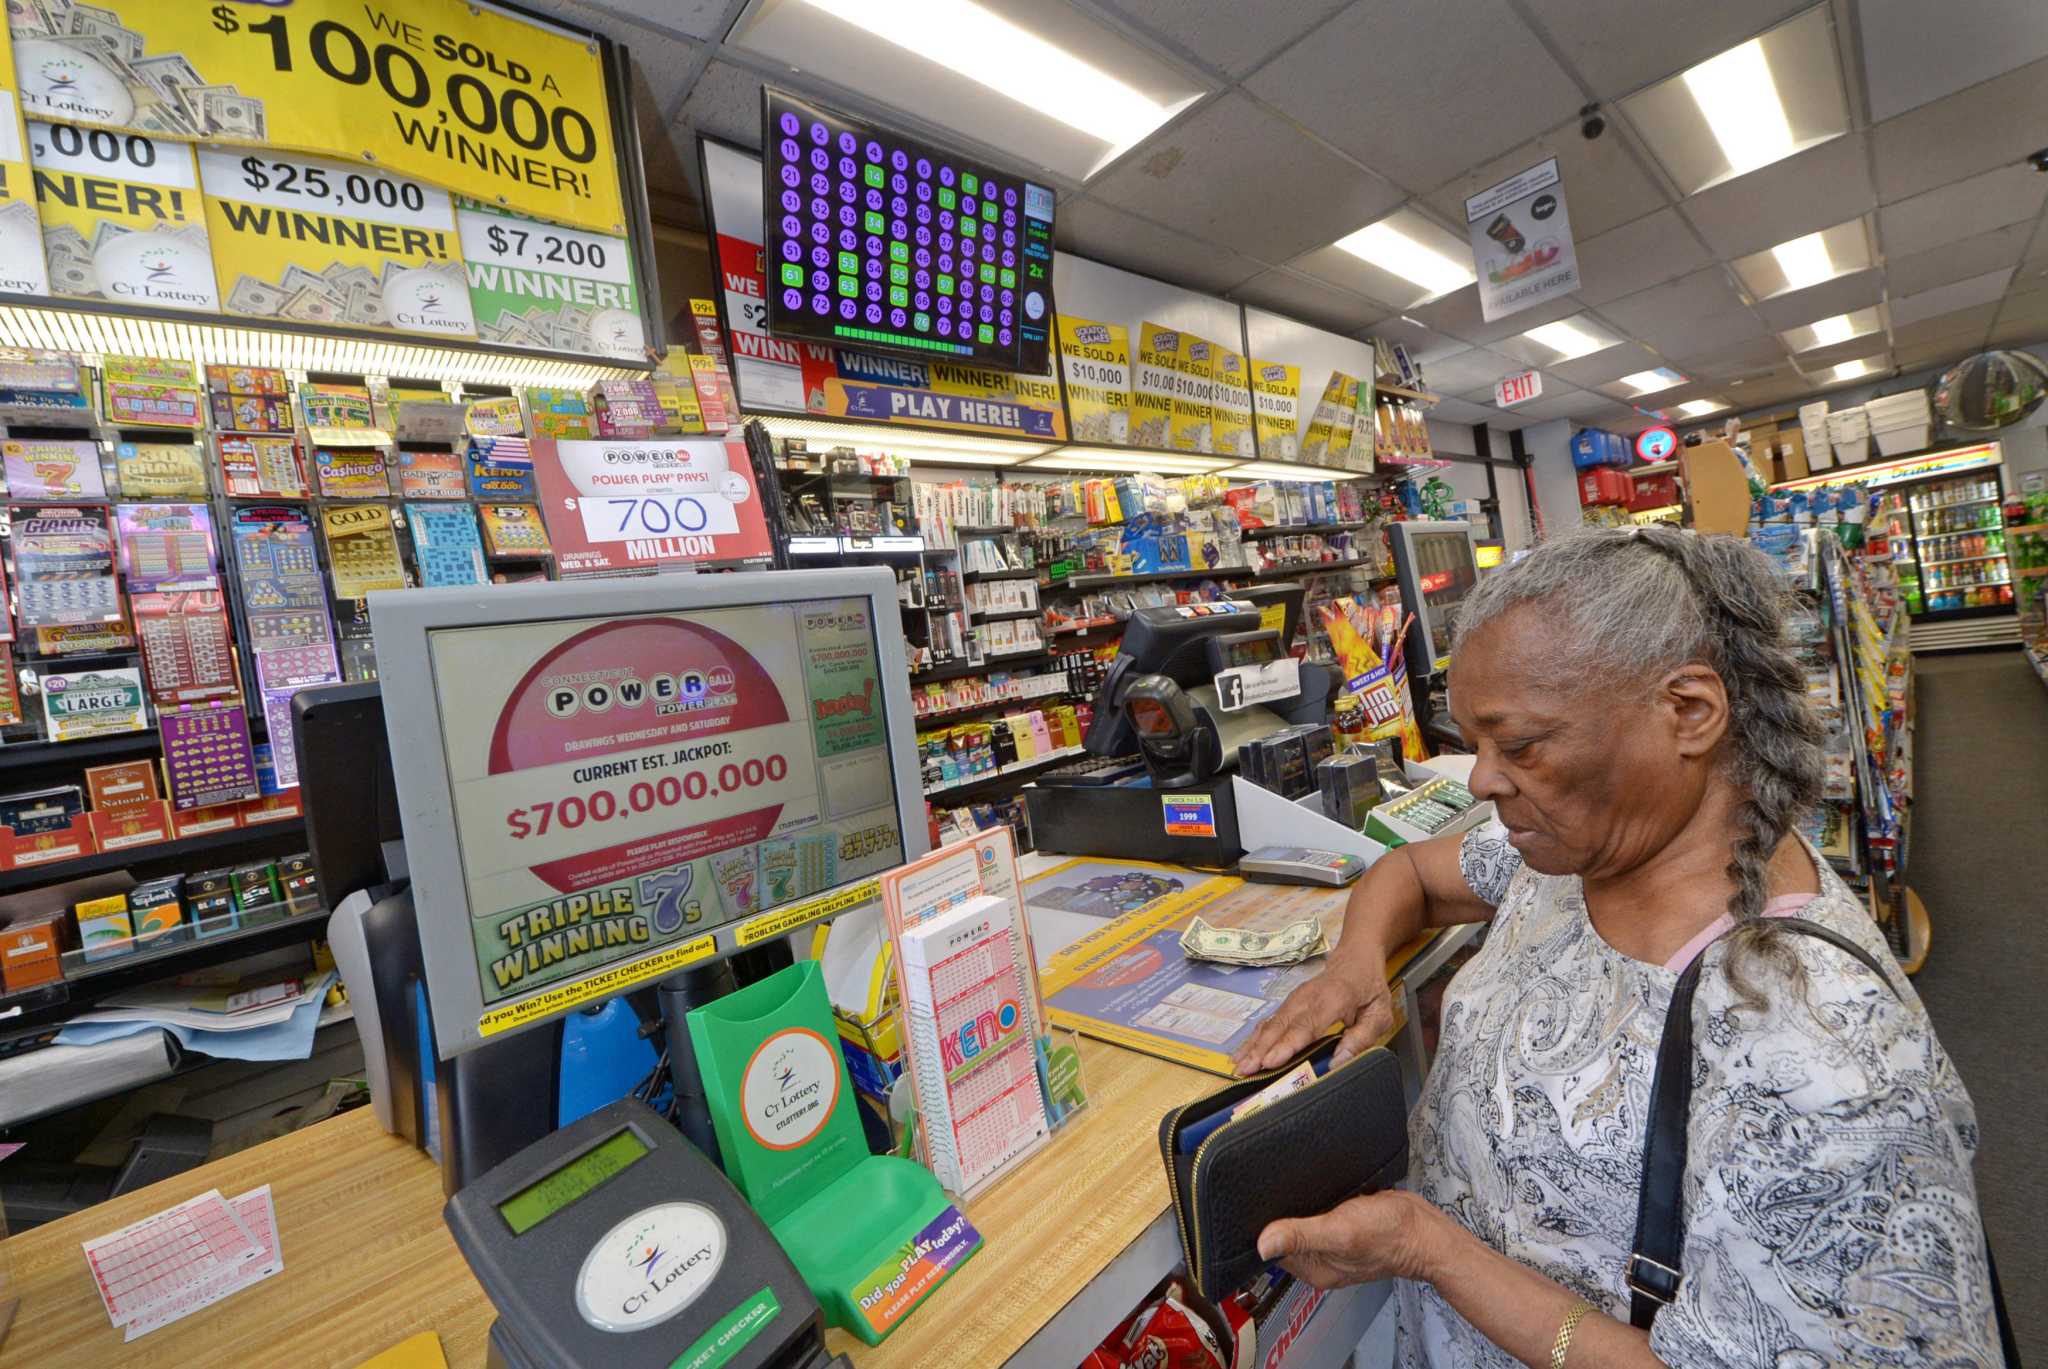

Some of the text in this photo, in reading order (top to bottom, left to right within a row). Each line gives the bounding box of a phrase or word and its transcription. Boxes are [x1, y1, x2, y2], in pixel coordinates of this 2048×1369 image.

[363, 3, 561, 98] WE SOLD A
[212, 4, 597, 163] $100,000
[45, 96, 115, 120] Lottery
[393, 111, 591, 199] WINNER!
[785, 144, 905, 190] 11 12 13 15
[241, 156, 425, 212] $25,000
[785, 170, 880, 205] 21 22 23 24
[786, 195, 853, 222] 31 32 33
[219, 200, 448, 260] WINNER!
[785, 221, 881, 251] 41 42 43 44
[487, 225, 607, 269] $7,200
[787, 245, 881, 274] 51 52 54
[466, 262, 632, 310] WINNER!
[725, 272, 759, 296] WE
[814, 274, 880, 296] 62 64
[1543, 270, 1573, 289] HERE
[145, 284, 209, 305] Lottery
[787, 293, 880, 318] 71 72 73 74
[421, 316, 469, 331] Lottery
[1063, 343, 1126, 365] WE SOLD A
[1140, 351, 1152, 363] WE
[841, 352, 929, 385] WINNER!
[935, 366, 1009, 391] WINNER!
[1072, 362, 1122, 384] $10,000
[1190, 362, 1209, 377] SOLD
[1069, 384, 1128, 407] WINNER!
[1254, 382, 1296, 397] WE SOLD A
[1503, 373, 1534, 404] EXIT
[891, 392, 950, 419] PLAY
[961, 402, 1020, 427] HERE!
[1259, 396, 1292, 413] $10,000
[1256, 414, 1295, 431] WINNER!
[604, 450, 676, 464] POWER
[319, 463, 384, 479] Cashingo
[592, 472, 709, 486] POWER PLAY PAYS!
[329, 508, 381, 526] GOLD
[564, 498, 577, 511] $
[608, 497, 707, 533] 700
[24, 518, 100, 534] GIANTS
[563, 550, 602, 561] DRAWINGS
[624, 536, 716, 560] MILLION
[560, 559, 584, 569] WED.
[593, 557, 611, 567] SAT.
[48, 679, 66, 690] $20
[553, 674, 702, 712] POWER
[1230, 678, 1240, 707] f
[67, 696, 124, 712] LARGE
[565, 716, 731, 752] DRAWINGS WEDNESDAY AND SATURDAY
[573, 741, 732, 784] CURRENT EST. JACKPOT:
[102, 793, 149, 808] Naturals
[505, 754, 788, 841] $700,000,000
[1180, 812, 1198, 821] 1999
[500, 886, 634, 948] TRIPLE
[744, 896, 856, 945] PROBLEM GAMBLING HELPLINE
[949, 926, 982, 946] POWER
[1060, 944, 1081, 957] DID
[1084, 930, 1104, 943] YOU
[491, 916, 649, 989] WINNING
[493, 942, 713, 1023] you Win? Use the TICKET CHECKER to find out.
[940, 999, 1021, 1072] KENO
[782, 1080, 821, 1110] Lottery
[776, 1099, 821, 1131] CTLOTTERY.ORG
[650, 1244, 713, 1294] Lottery
[860, 1216, 965, 1311] Did you PLAY today?
[884, 1294, 909, 1319] PLEASE
[909, 1279, 927, 1297] PLAY
[717, 1304, 767, 1345] CHECKER
